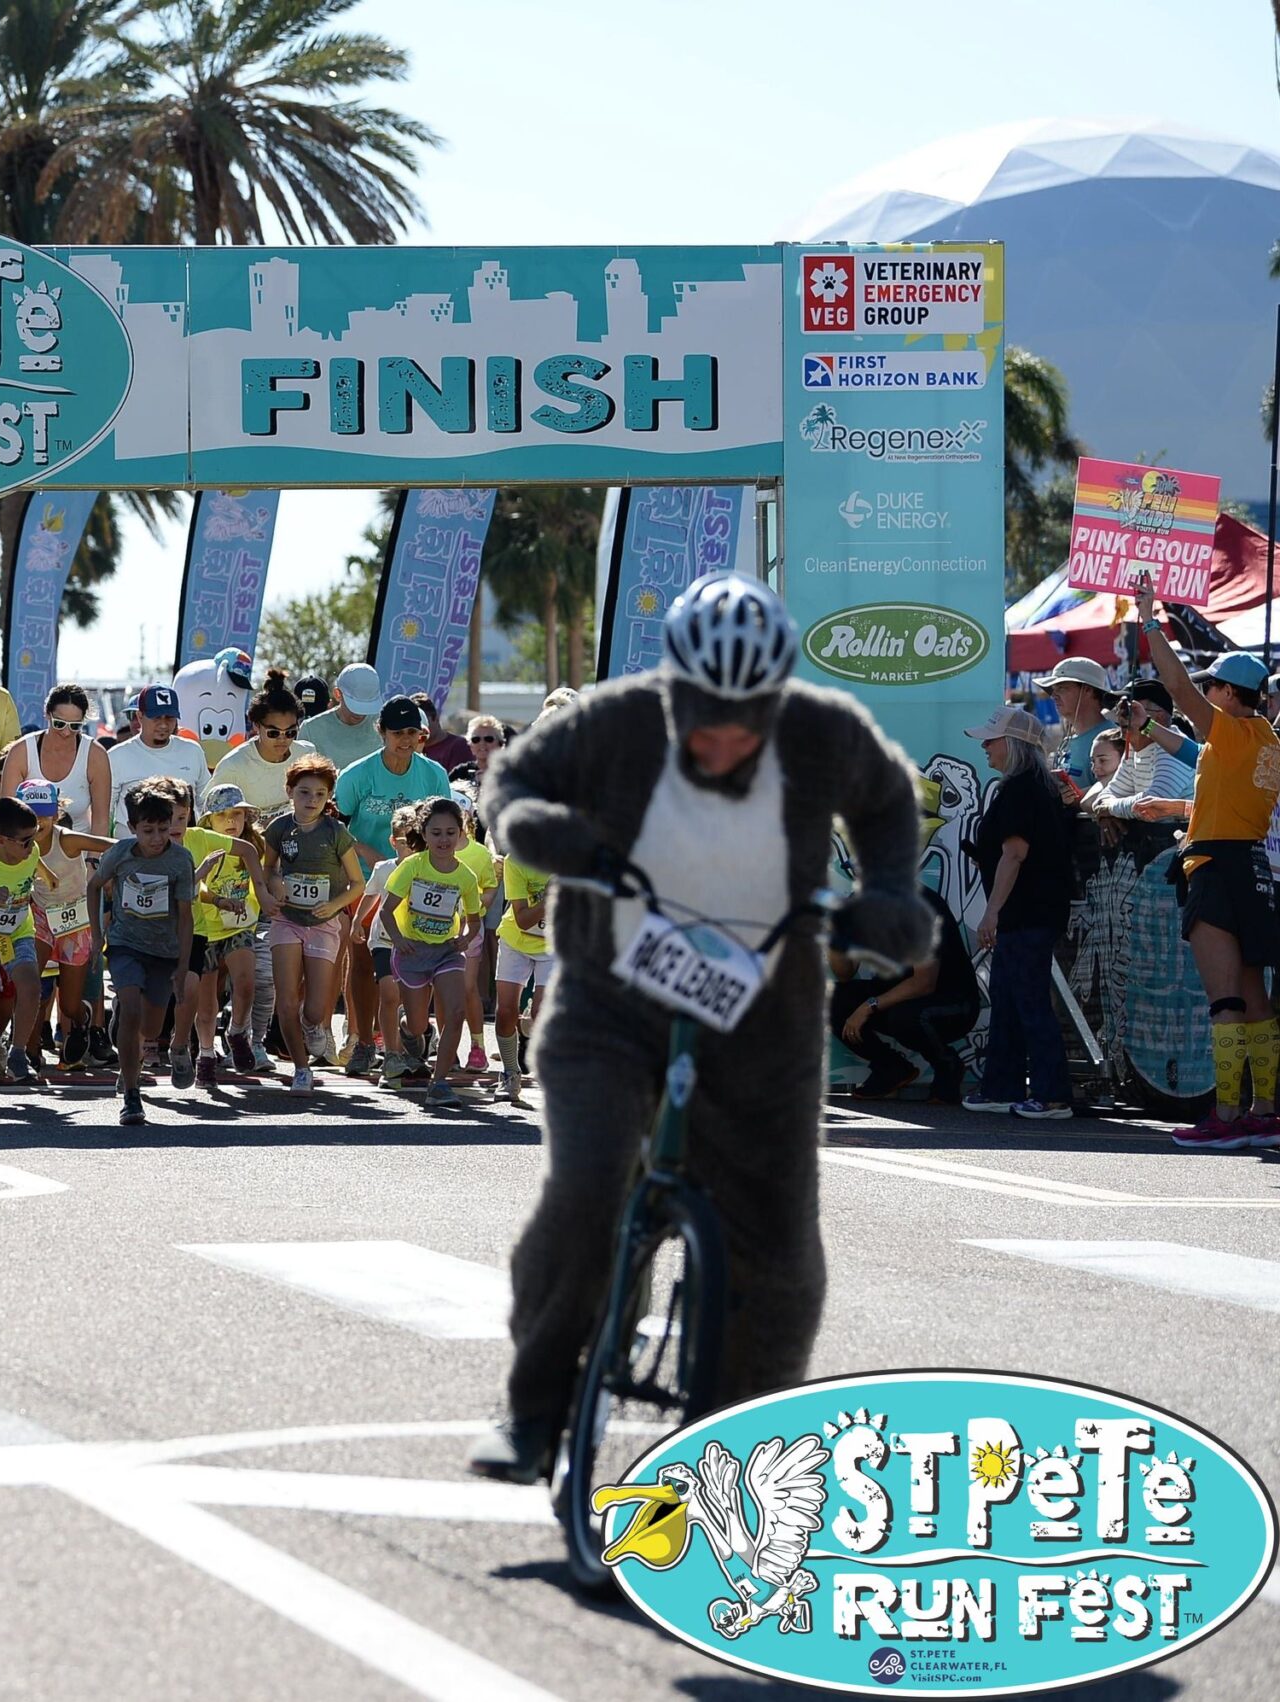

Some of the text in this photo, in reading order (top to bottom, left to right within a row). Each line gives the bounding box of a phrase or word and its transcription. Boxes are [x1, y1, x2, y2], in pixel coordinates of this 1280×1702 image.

[863, 262, 982, 281] VETERINARY
[864, 284, 982, 303] EMERGENCY
[810, 307, 930, 326] VEG GROUP
[838, 356, 887, 369] FIRST
[838, 371, 979, 387] HORIZON BANK
[241, 353, 719, 434] FINISH
[876, 492, 924, 509] DUKE
[876, 511, 949, 529] ENERGY
[1073, 526, 1213, 567] PINK GROUP
[1070, 551, 1209, 600] ONE ME RUN
[913, 624, 973, 658] Oats
[870, 671, 920, 682] MARKET
[25, 792, 48, 801] SQUAD
[292, 883, 319, 899] 219
[423, 891, 442, 908] 82
[136, 895, 153, 908] 85
[0, 914, 17, 927] 94
[61, 908, 77, 924] 99
